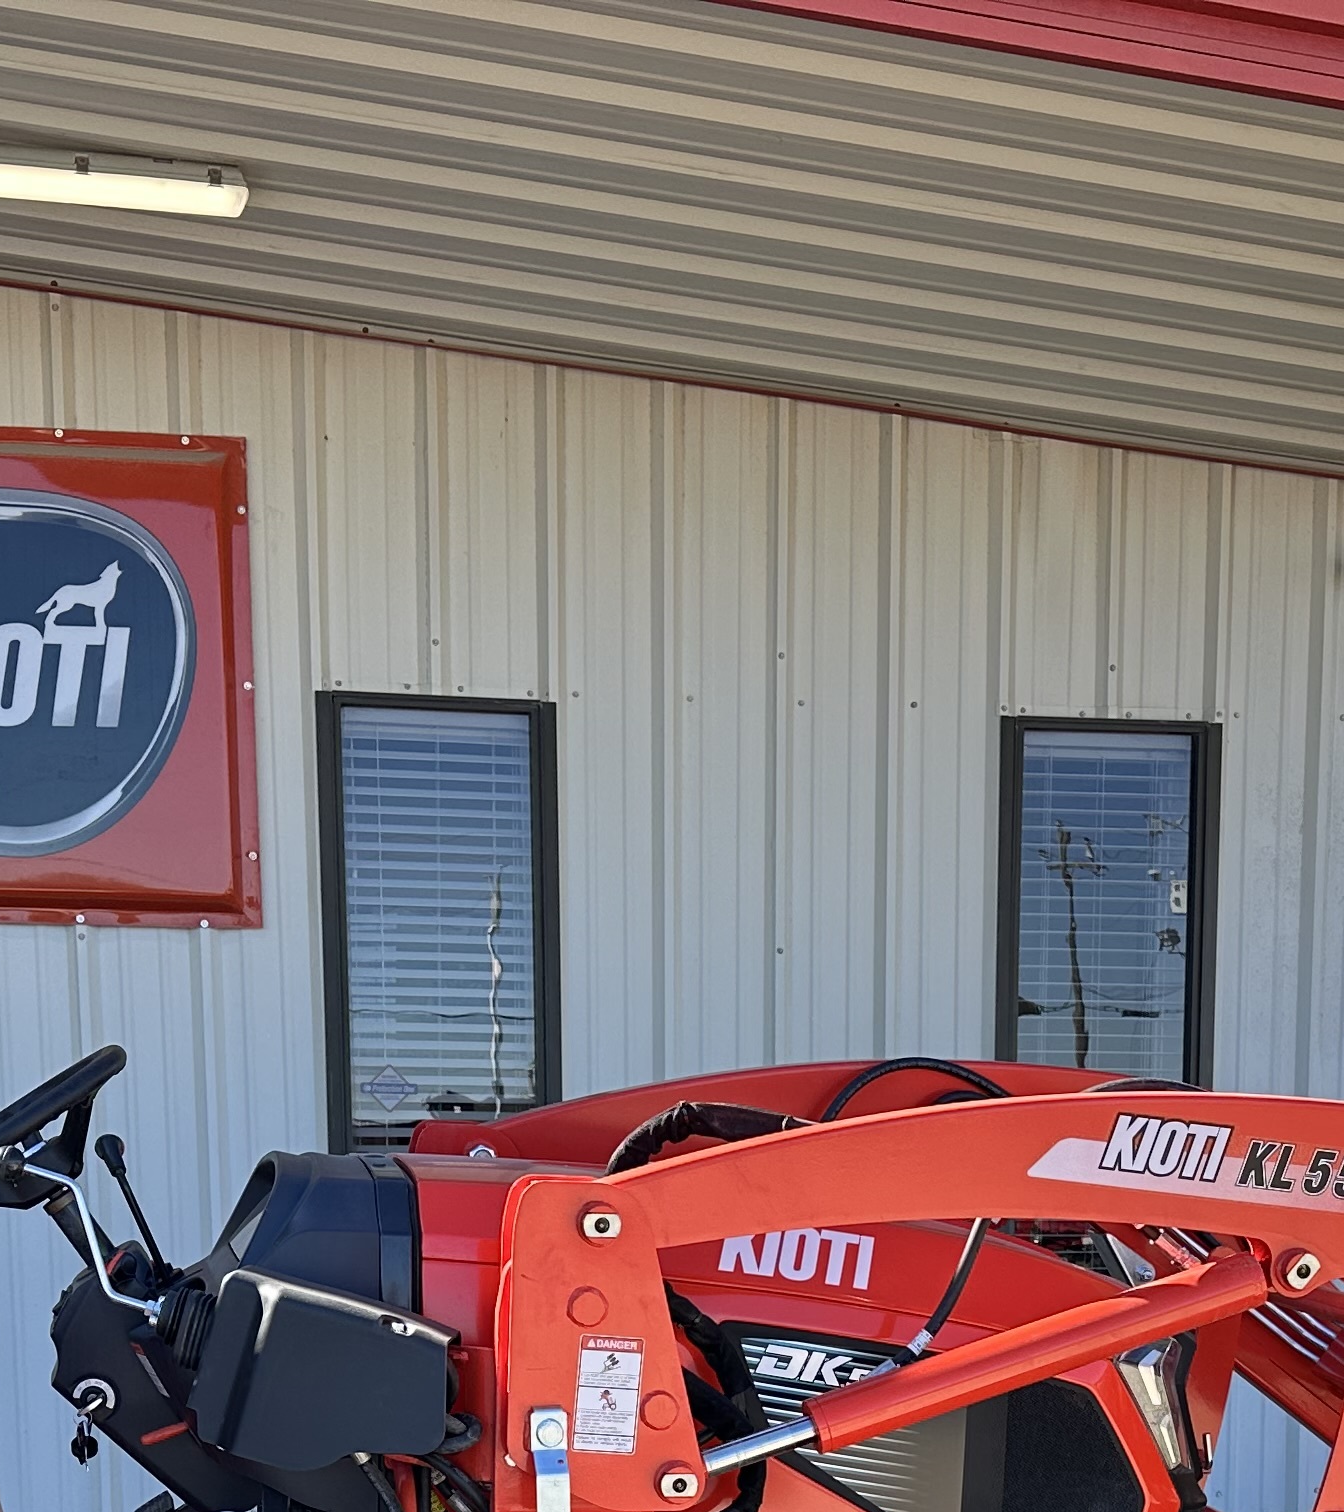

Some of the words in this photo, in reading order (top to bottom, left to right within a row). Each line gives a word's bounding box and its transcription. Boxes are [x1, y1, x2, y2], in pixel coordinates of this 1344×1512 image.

[1099, 1112, 1234, 1183] KIOTI
[1236, 1139, 1296, 1193] KL
[717, 1228, 875, 1290] KIOTI
[596, 1339, 638, 1350] DANGER
